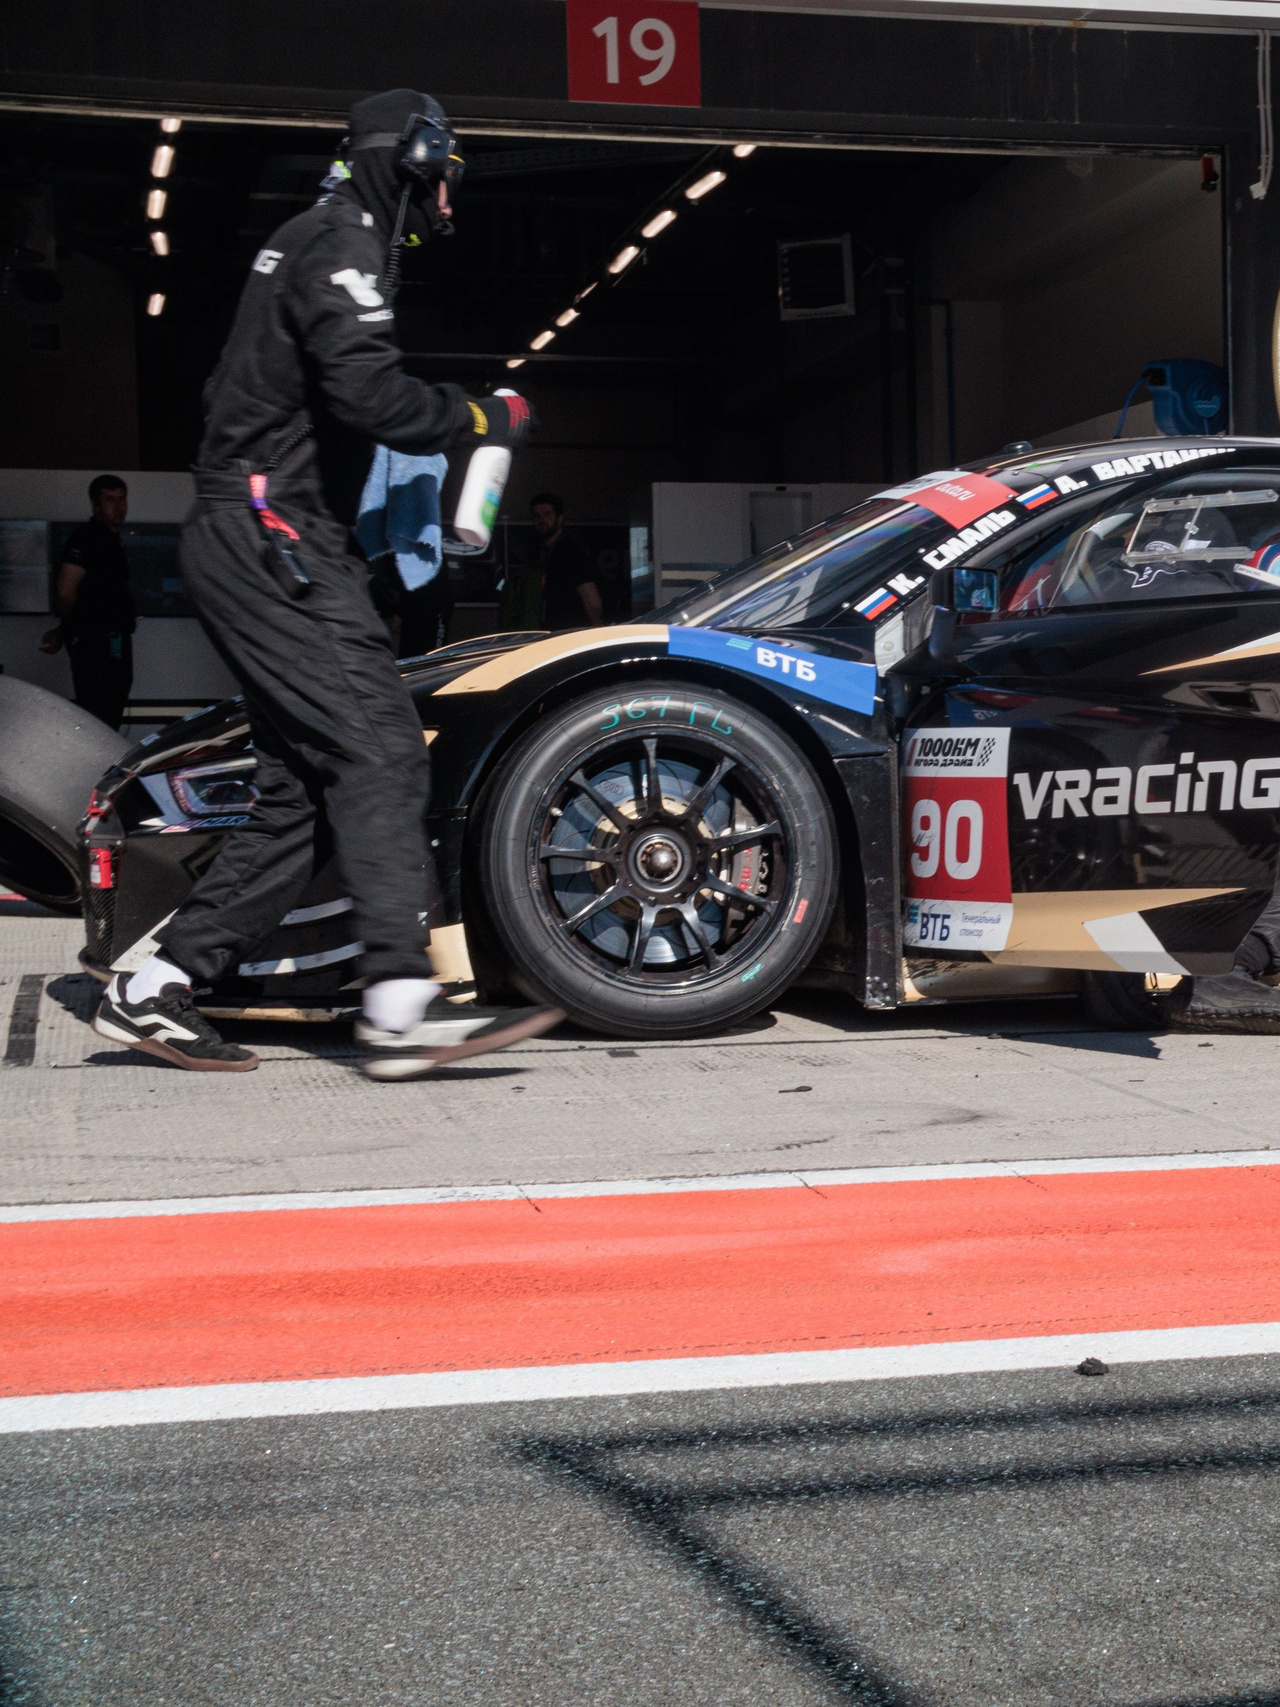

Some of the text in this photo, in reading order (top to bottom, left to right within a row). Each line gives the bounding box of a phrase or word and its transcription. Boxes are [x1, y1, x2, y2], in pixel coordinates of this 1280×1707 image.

[592, 16, 677, 86] 19
[1091, 448, 1237, 481] ВАРТАН
[922, 510, 1017, 570] СМАЛЬ
[756, 647, 817, 681] ВТБ
[911, 798, 984, 880] 90
[919, 913, 952, 941] ВТБ
